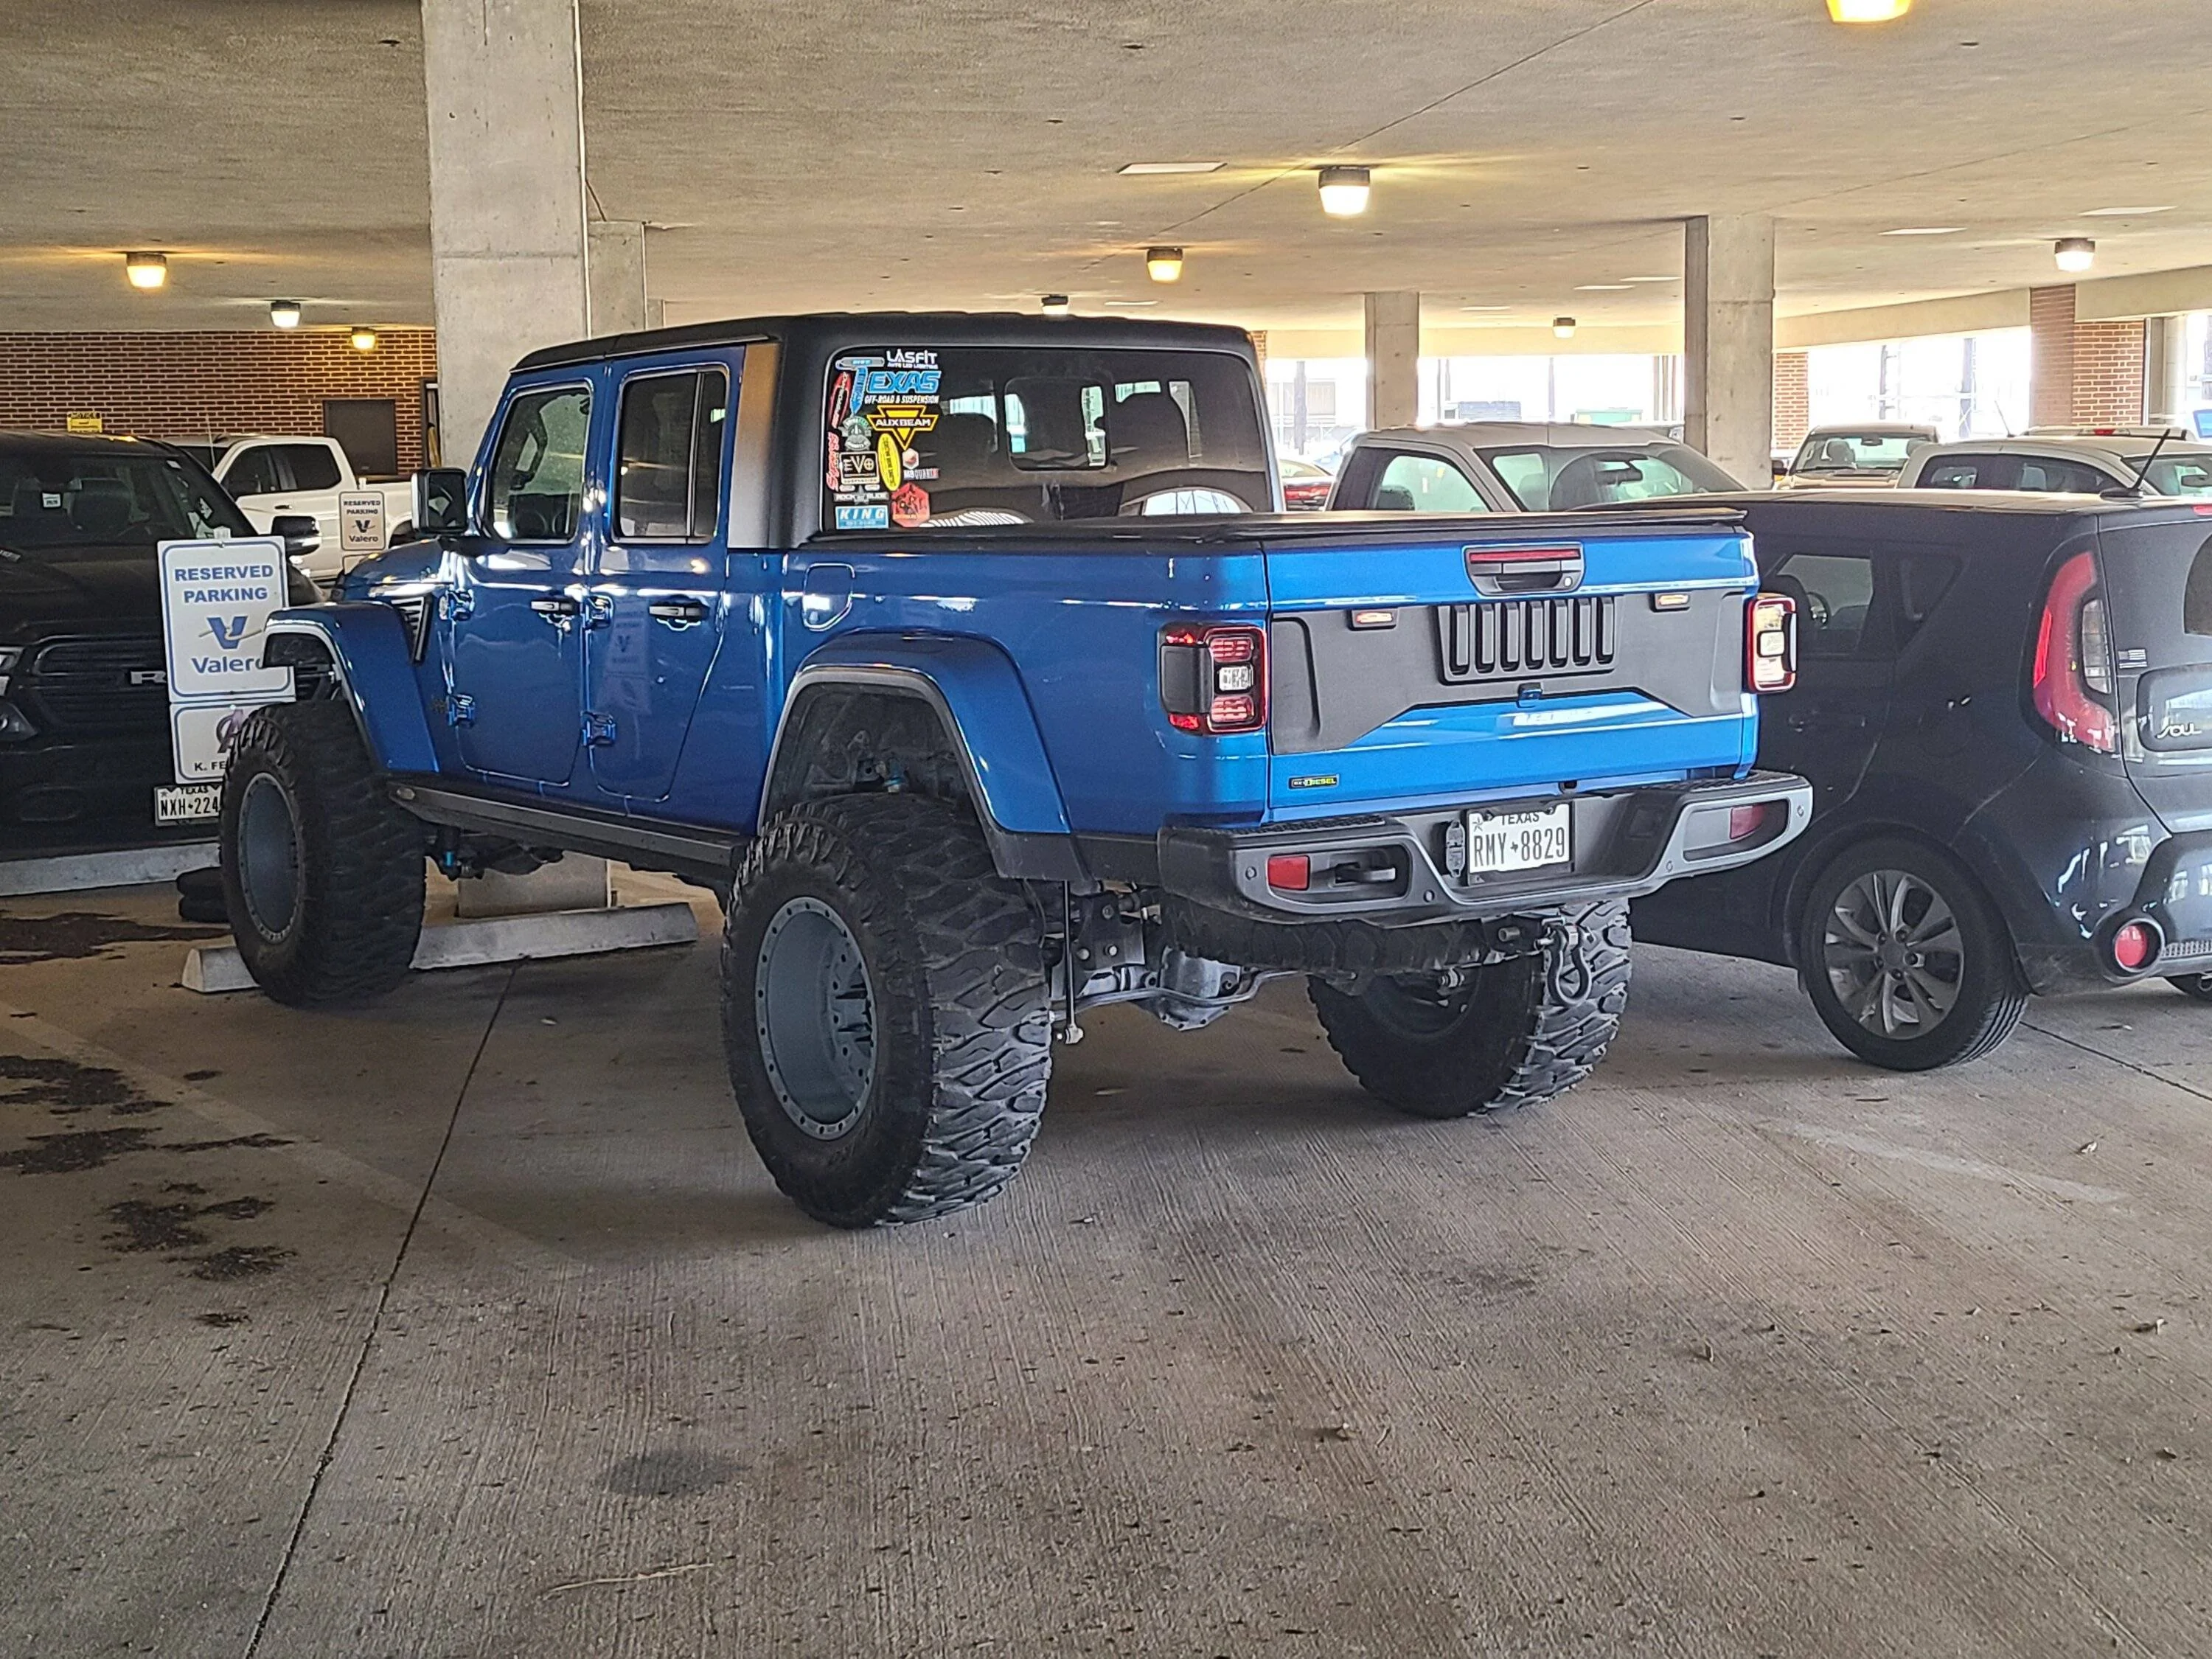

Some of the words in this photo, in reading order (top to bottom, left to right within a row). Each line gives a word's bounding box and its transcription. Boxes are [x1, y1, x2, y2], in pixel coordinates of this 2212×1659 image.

[875, 418, 931, 427] AUXBEAM
[839, 507, 885, 520] KING
[349, 535, 379, 543] Valero
[174, 565, 274, 582] RESERVED
[184, 587, 268, 603] PARKING
[194, 762, 207, 771] K.
[180, 786, 209, 794] TEXAS
[160, 797, 187, 817] NXH
[1501, 812, 1540, 826] TEXAS
[1474, 832, 1507, 868] RMY
[1520, 827, 1565, 862] 8829
